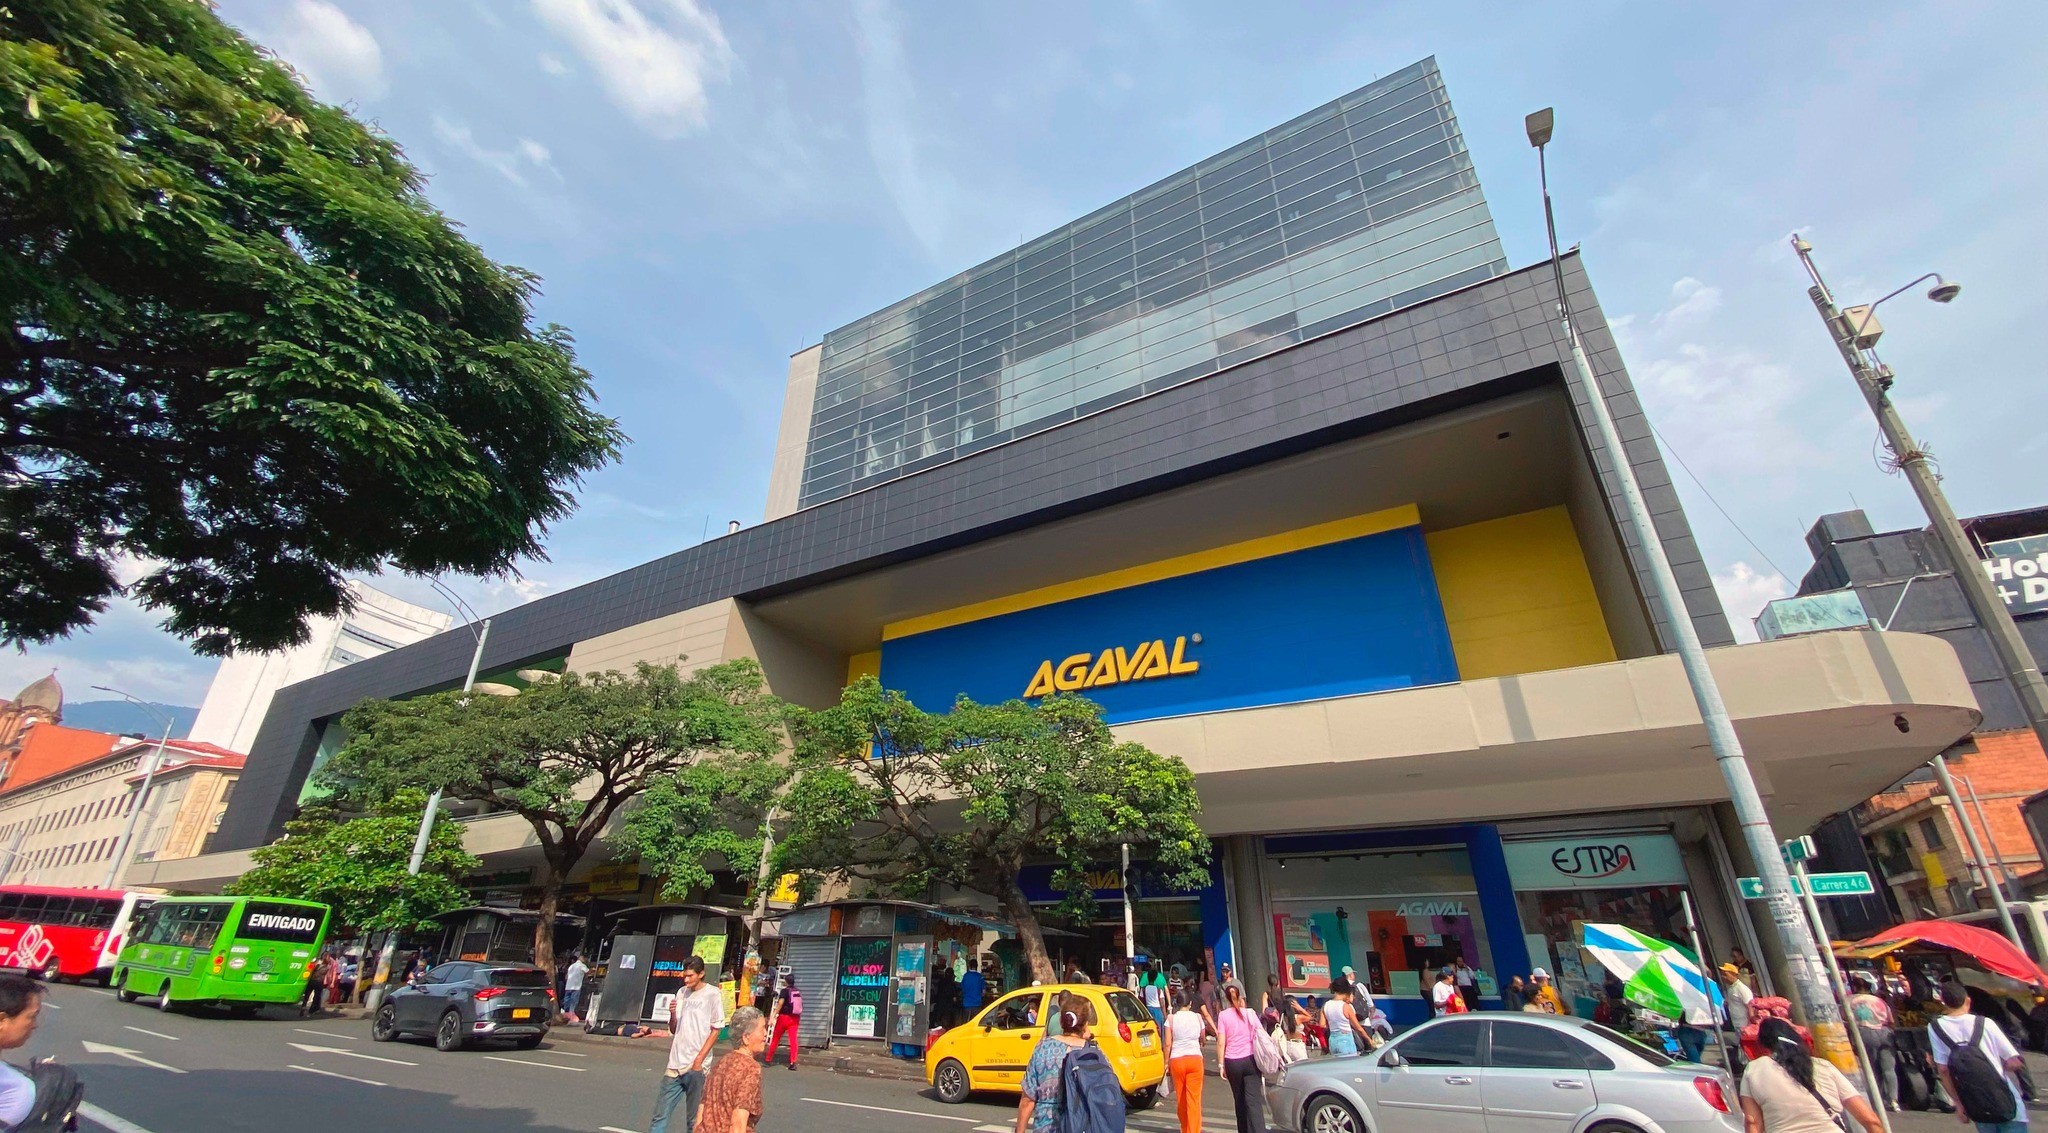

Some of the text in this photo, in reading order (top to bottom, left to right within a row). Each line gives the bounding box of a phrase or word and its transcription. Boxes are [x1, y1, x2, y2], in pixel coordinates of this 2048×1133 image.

[1023, 635, 1199, 698] AGAVAL
[1551, 844, 1636, 874] ESTRA
[1814, 877, 1865, 891] Carrera 46
[1395, 901, 1469, 916] AGAVAL
[248, 913, 316, 931] ENVIGADO
[847, 963, 884, 975] YO SOY
[841, 973, 889, 987] MEDELLÍN
